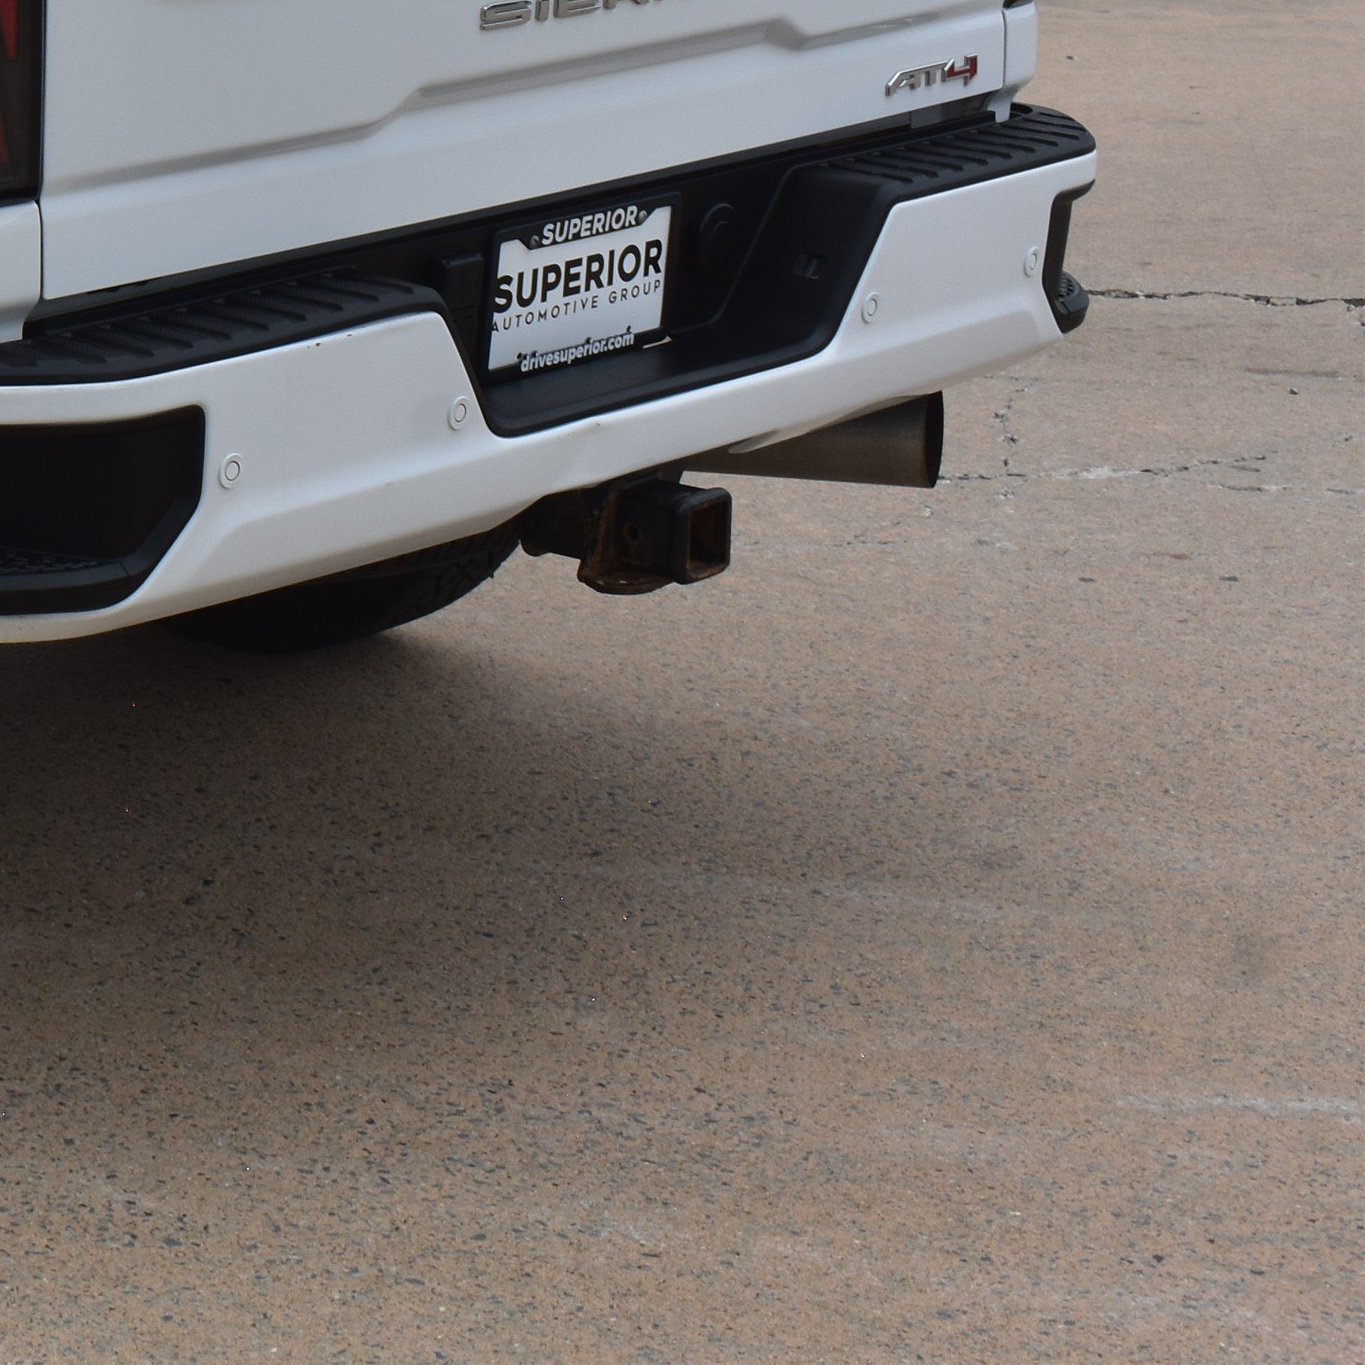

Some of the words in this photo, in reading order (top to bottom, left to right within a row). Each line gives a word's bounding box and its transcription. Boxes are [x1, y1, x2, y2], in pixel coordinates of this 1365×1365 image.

[885, 54, 978, 97] AT4
[541, 205, 637, 246] SUPERIOR
[493, 239, 663, 314] SUPERIOR
[491, 295, 599, 333] AUTOMOTIVE
[608, 279, 662, 305] GROUP
[521, 331, 635, 373] drivesuperior.com
